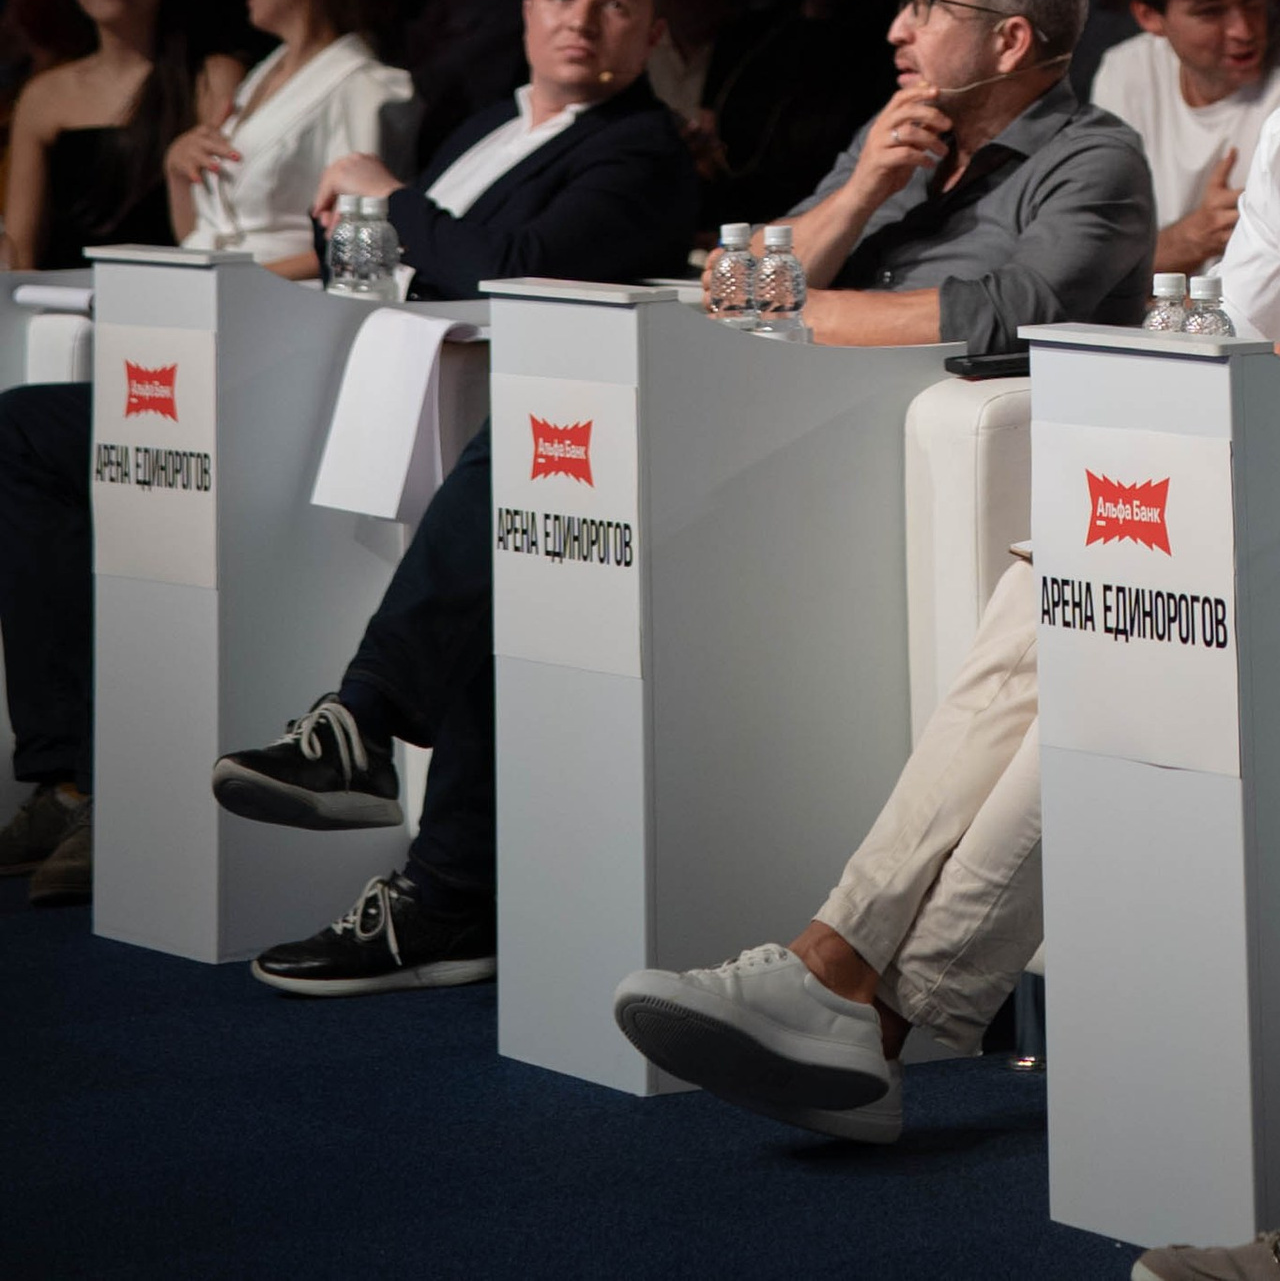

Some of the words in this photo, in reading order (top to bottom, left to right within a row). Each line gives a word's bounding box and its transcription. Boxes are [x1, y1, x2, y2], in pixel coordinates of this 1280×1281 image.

[95, 443, 131, 484] АРЕНА
[135, 446, 211, 492] ЕДИНОРОГОВ
[497, 507, 539, 555] АРЕНА
[543, 513, 633, 568] ЕДИНОРОГОВ
[1096, 496, 1131, 525] Альфа
[1133, 499, 1161, 524] Банк
[1041, 576, 1096, 632] АРЕНА
[1102, 584, 1228, 649] ЕДИНОРОГОВ
